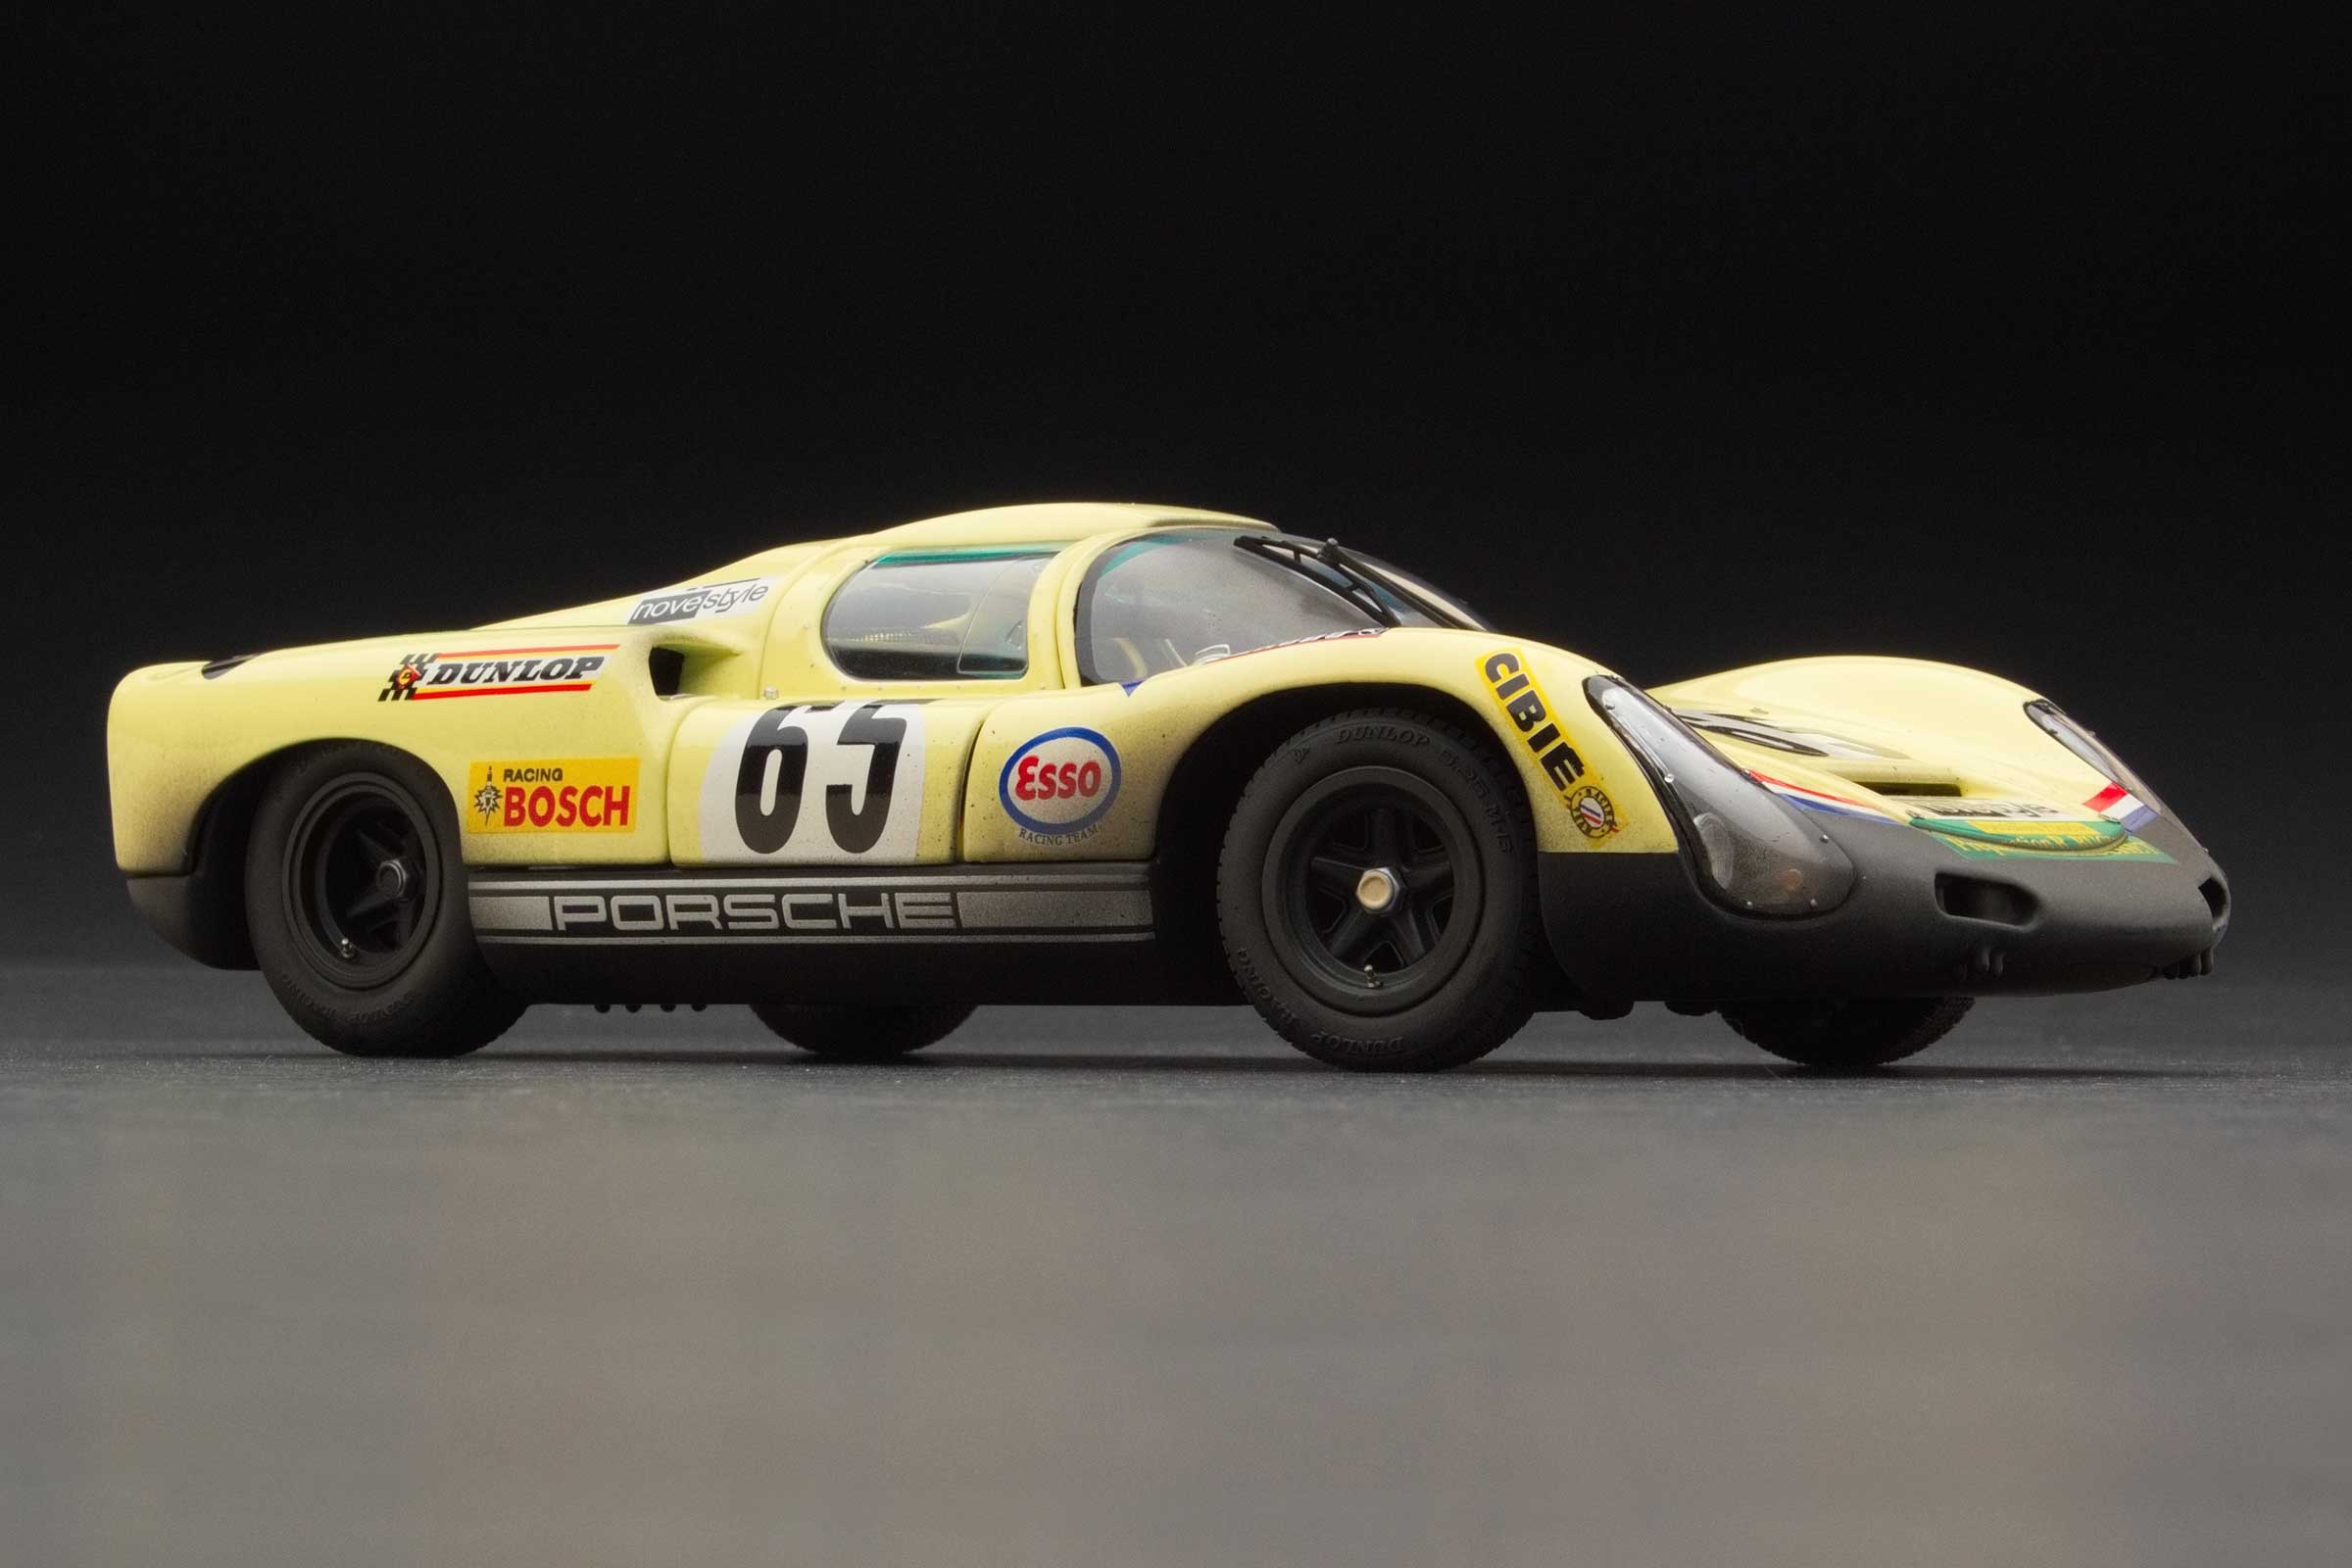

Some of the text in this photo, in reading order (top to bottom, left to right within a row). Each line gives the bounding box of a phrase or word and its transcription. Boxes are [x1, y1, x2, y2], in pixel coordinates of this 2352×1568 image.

[425, 655, 606, 686] DUNLOP
[1335, 725, 1431, 746] DUNLOP
[503, 767, 564, 783] RACING
[735, 699, 933, 855] 65
[503, 785, 630, 827] BOSCH
[1019, 823, 1101, 847] RACING TEAM
[553, 891, 957, 933] PORSCHE
